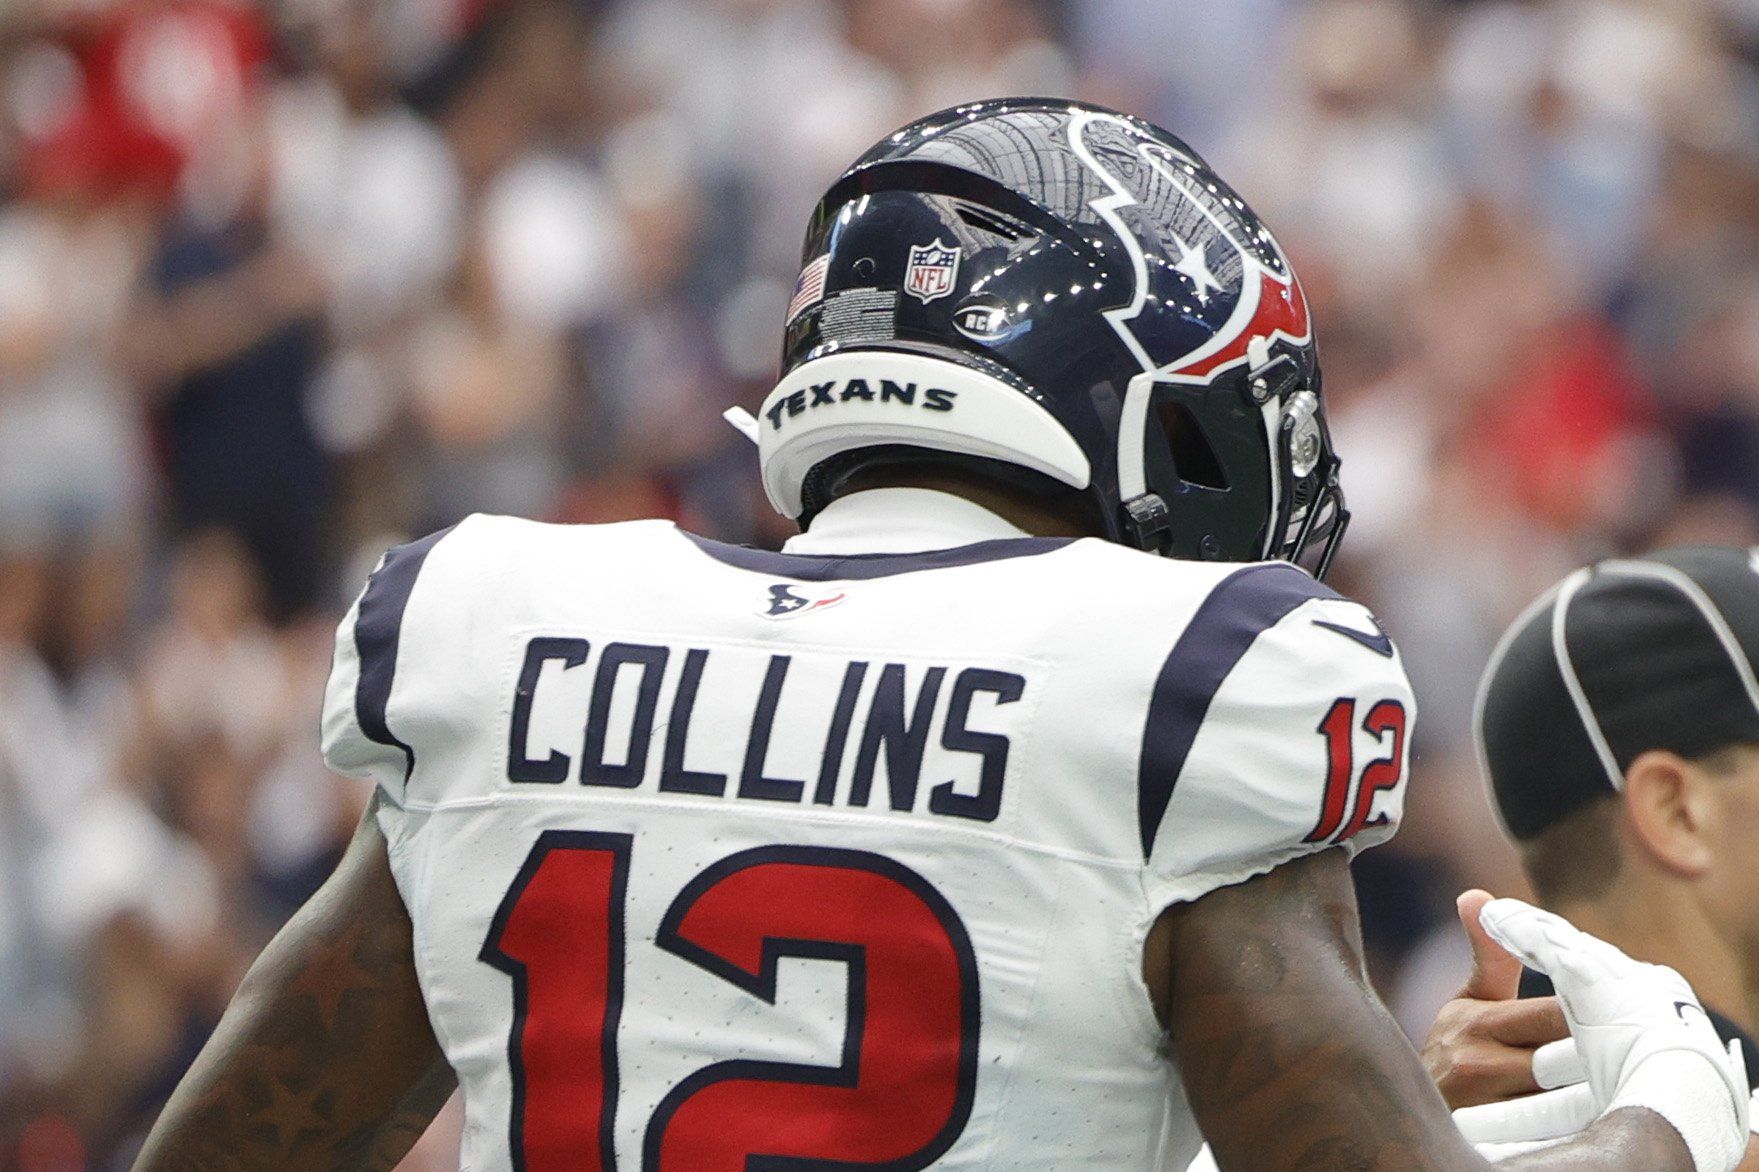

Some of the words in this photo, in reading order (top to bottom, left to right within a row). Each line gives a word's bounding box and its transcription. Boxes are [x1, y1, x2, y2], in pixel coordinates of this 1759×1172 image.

[911, 267, 947, 293] NFL
[766, 379, 959, 431] TEXANS
[506, 636, 1027, 822] COLLINS
[1300, 697, 1406, 845] 12
